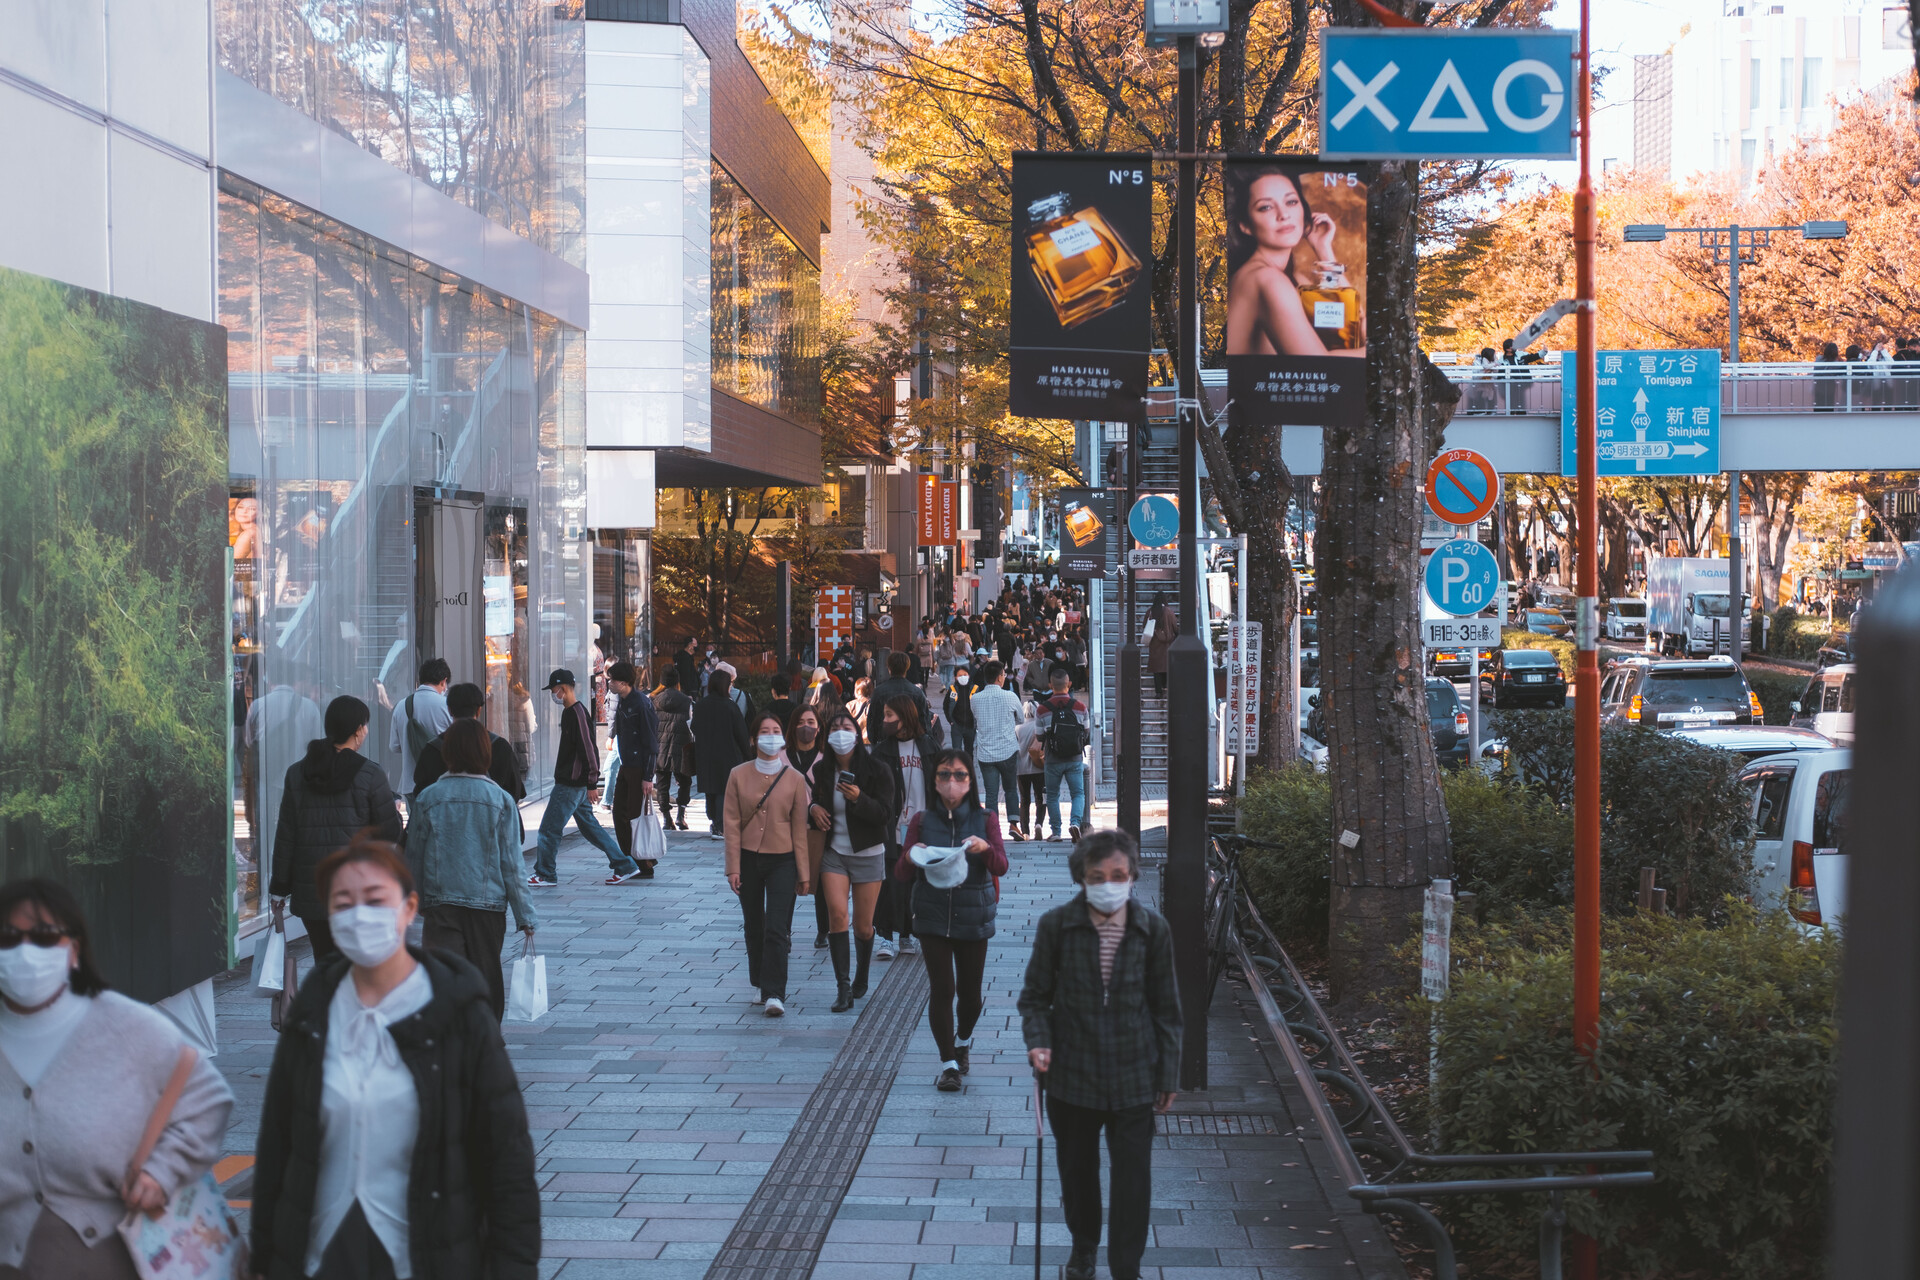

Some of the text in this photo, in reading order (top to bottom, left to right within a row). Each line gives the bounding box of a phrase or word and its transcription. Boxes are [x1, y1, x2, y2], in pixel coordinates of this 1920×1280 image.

[1051, 365, 1110, 376] HARAJUKU
[1269, 371, 1328, 381] HARAJUKU
[1644, 375, 1692, 387] Tomigaya
[1633, 414, 1648, 428] 413
[1666, 406, 1711, 425] 新宿
[1667, 427, 1710, 438] Shinjuku
[1448, 451, 1472, 461] 20-9
[1600, 446, 1614, 456] 305
[1617, 445, 1664, 457] 明治通り
[1446, 543, 1480, 556] 9-20
[1133, 554, 1178, 565] 歩行者優先
[1694, 569, 1730, 578] SAGAW
[1442, 557, 1470, 604] P
[1461, 582, 1482, 604] 60
[1244, 626, 1258, 738] 歩道は歩行者が優先
